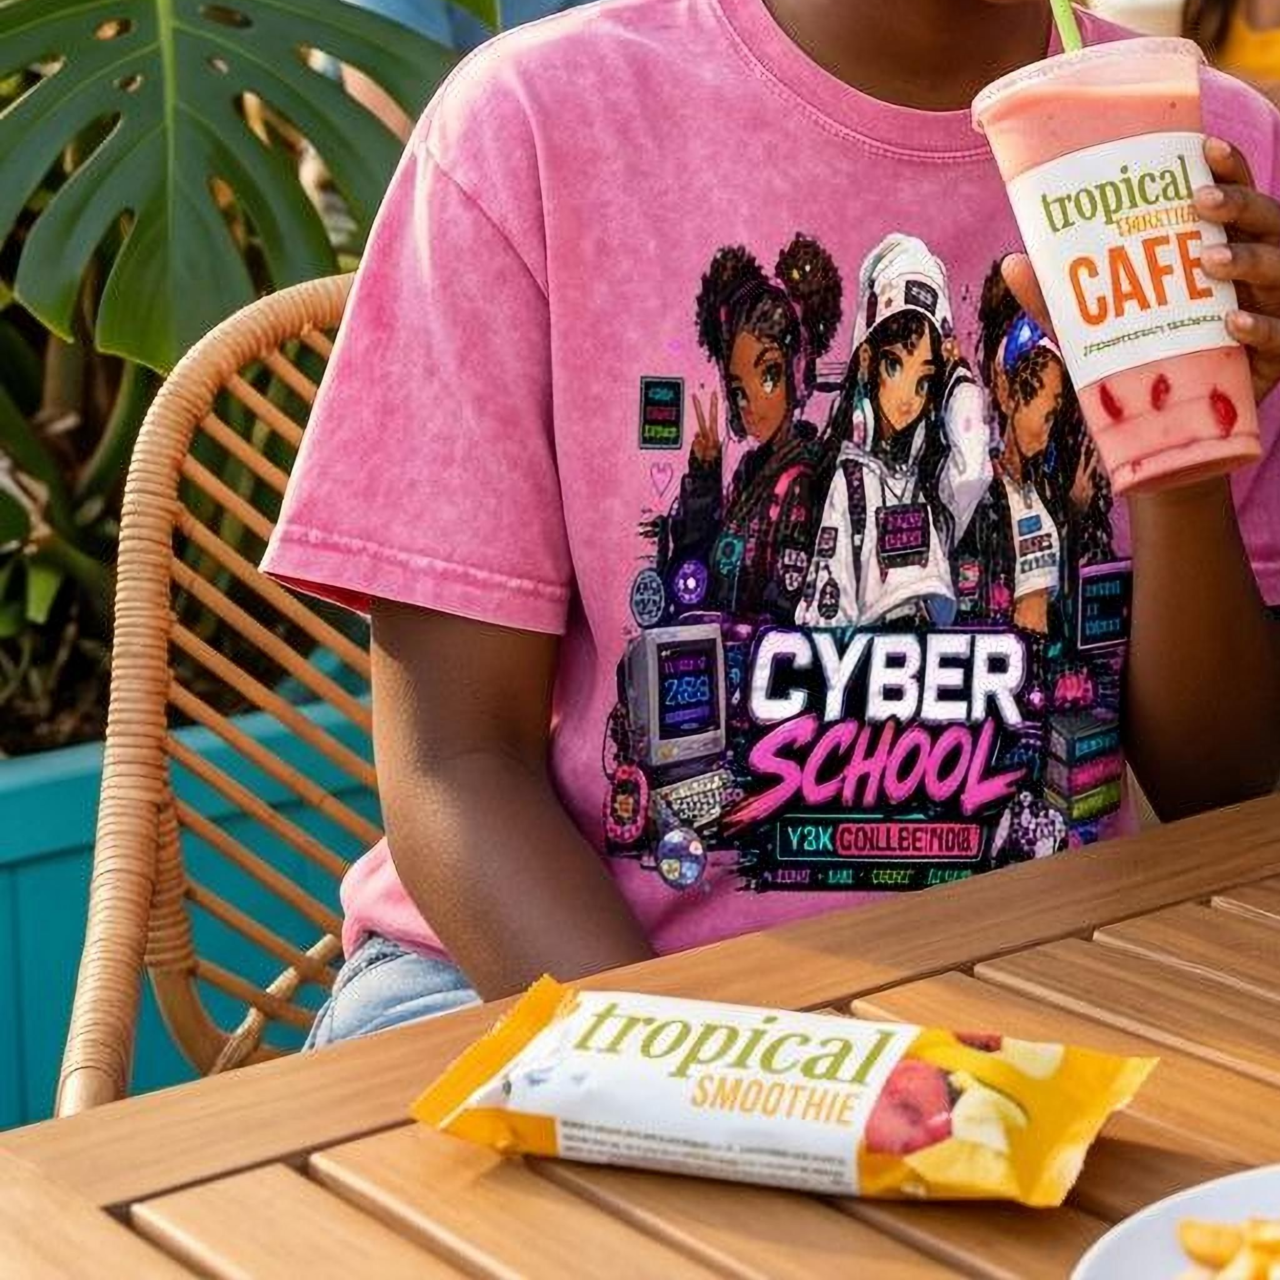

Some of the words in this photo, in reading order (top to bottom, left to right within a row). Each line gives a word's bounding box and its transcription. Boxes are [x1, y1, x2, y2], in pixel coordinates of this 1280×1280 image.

[1041, 155, 1194, 233] tropical
[1068, 230, 1214, 328] CAFE
[750, 629, 1025, 723] CYBER
[725, 715, 1027, 834] SCHOOL
[574, 1004, 895, 1083] tropical
[692, 1074, 857, 1124] SMOOTHIE
